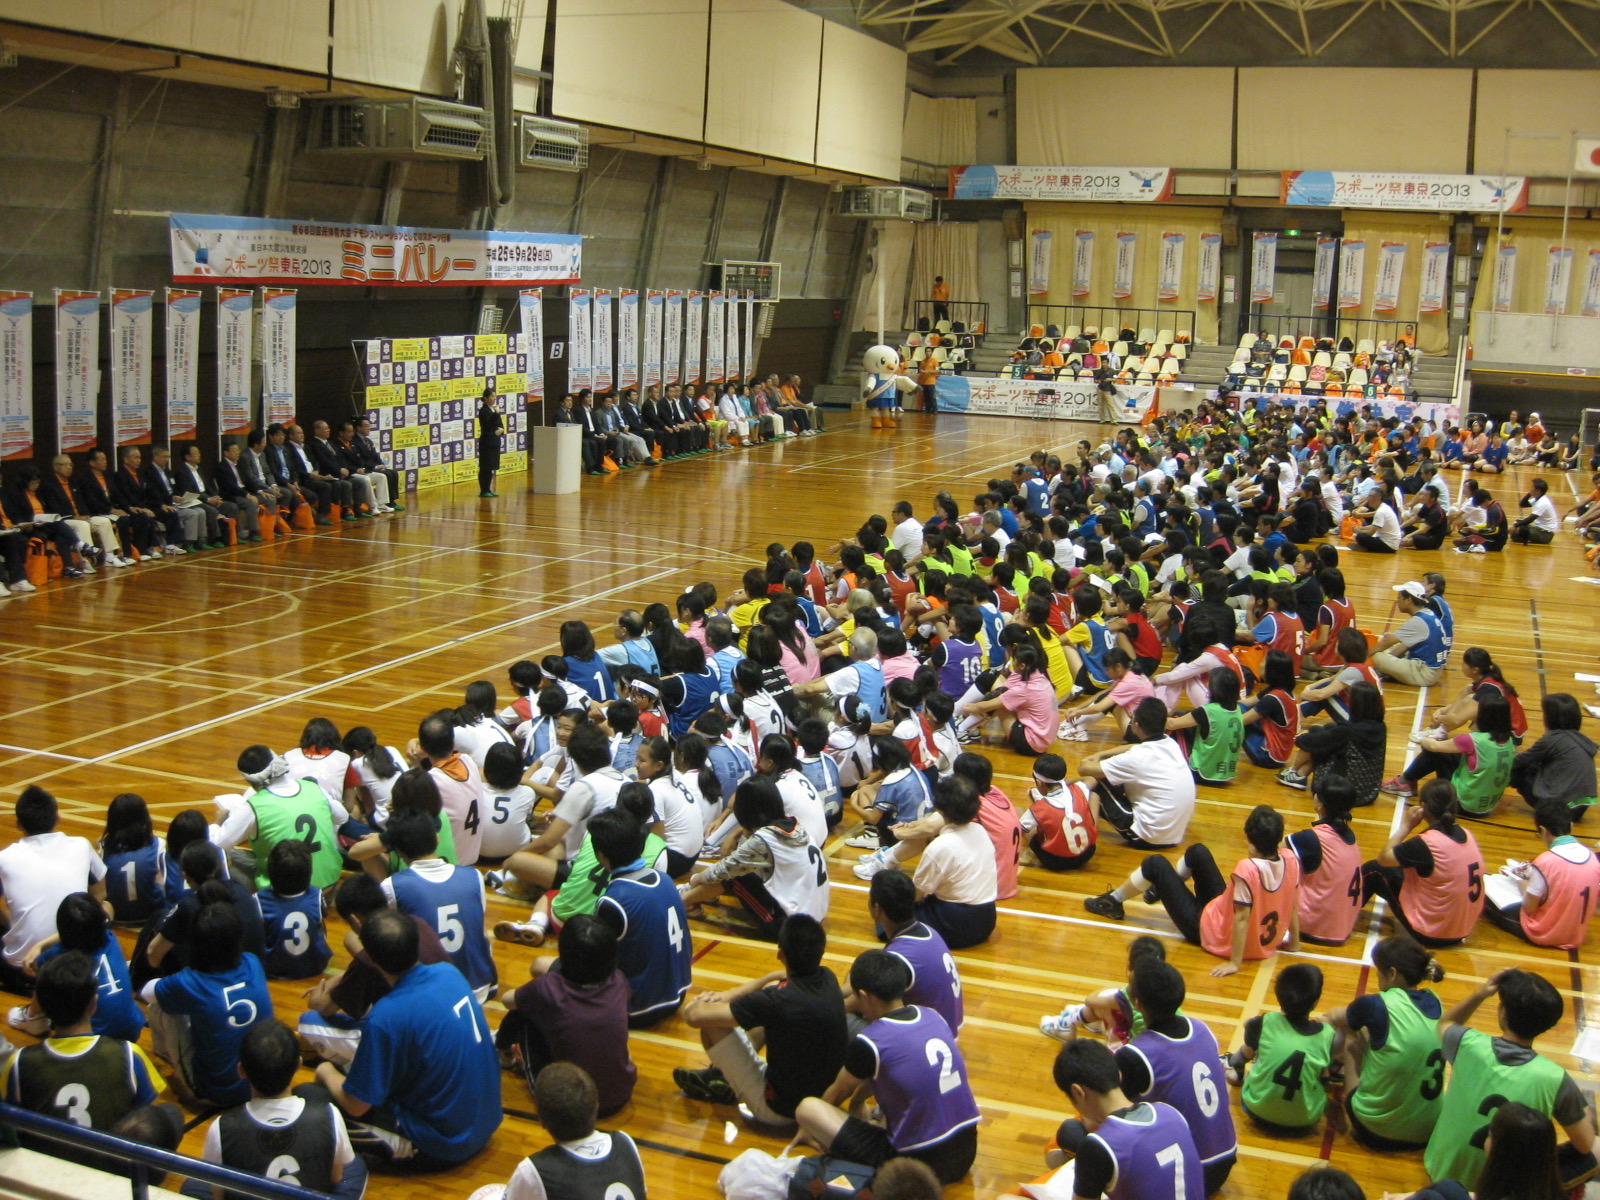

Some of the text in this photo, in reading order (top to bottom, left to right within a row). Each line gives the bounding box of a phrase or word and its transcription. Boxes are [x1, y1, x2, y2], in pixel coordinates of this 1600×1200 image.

[999, 172, 1120, 188] スポーツ祭東京2013
[1336, 179, 1470, 197] スポーツ祭東京2013
[224, 254, 332, 276] スポーツ祭東京2013
[340, 240, 477, 283] ミニバレー
[553, 344, 561, 358] B
[1014, 367, 1020, 377] 5
[1367, 386, 1374, 397] 6
[1040, 492, 1049, 509] 2
[1295, 630, 1304, 656] 5
[593, 671, 607, 701] 1
[960, 656, 981, 684] 10
[1228, 717, 1241, 754] 3
[851, 751, 865, 779] 1
[1494, 751, 1509, 788] 5
[677, 782, 695, 804] 8
[799, 778, 816, 801] 3
[464, 799, 480, 835] 4
[492, 797, 511, 825] 5
[295, 813, 321, 853] 2
[1061, 813, 1089, 856] 6
[121, 861, 136, 901] 1
[588, 865, 610, 898] 4
[808, 845, 828, 887] 2
[1467, 862, 1482, 904] 5
[1347, 866, 1361, 907] 4
[1579, 886, 1590, 924] 1
[283, 911, 310, 956] 3
[437, 904, 464, 953] 5
[667, 906, 683, 953] 4
[1260, 910, 1278, 947] 3
[95, 953, 123, 996] 4
[943, 952, 960, 999] 3
[223, 981, 258, 1027] 5
[453, 995, 482, 1044] 7
[925, 1037, 962, 1095] 2
[1272, 1049, 1306, 1102] 4
[1420, 1048, 1446, 1101] 3
[55, 1083, 92, 1129] 3
[1191, 1060, 1220, 1118] 6
[1155, 1142, 1186, 1200] 7
